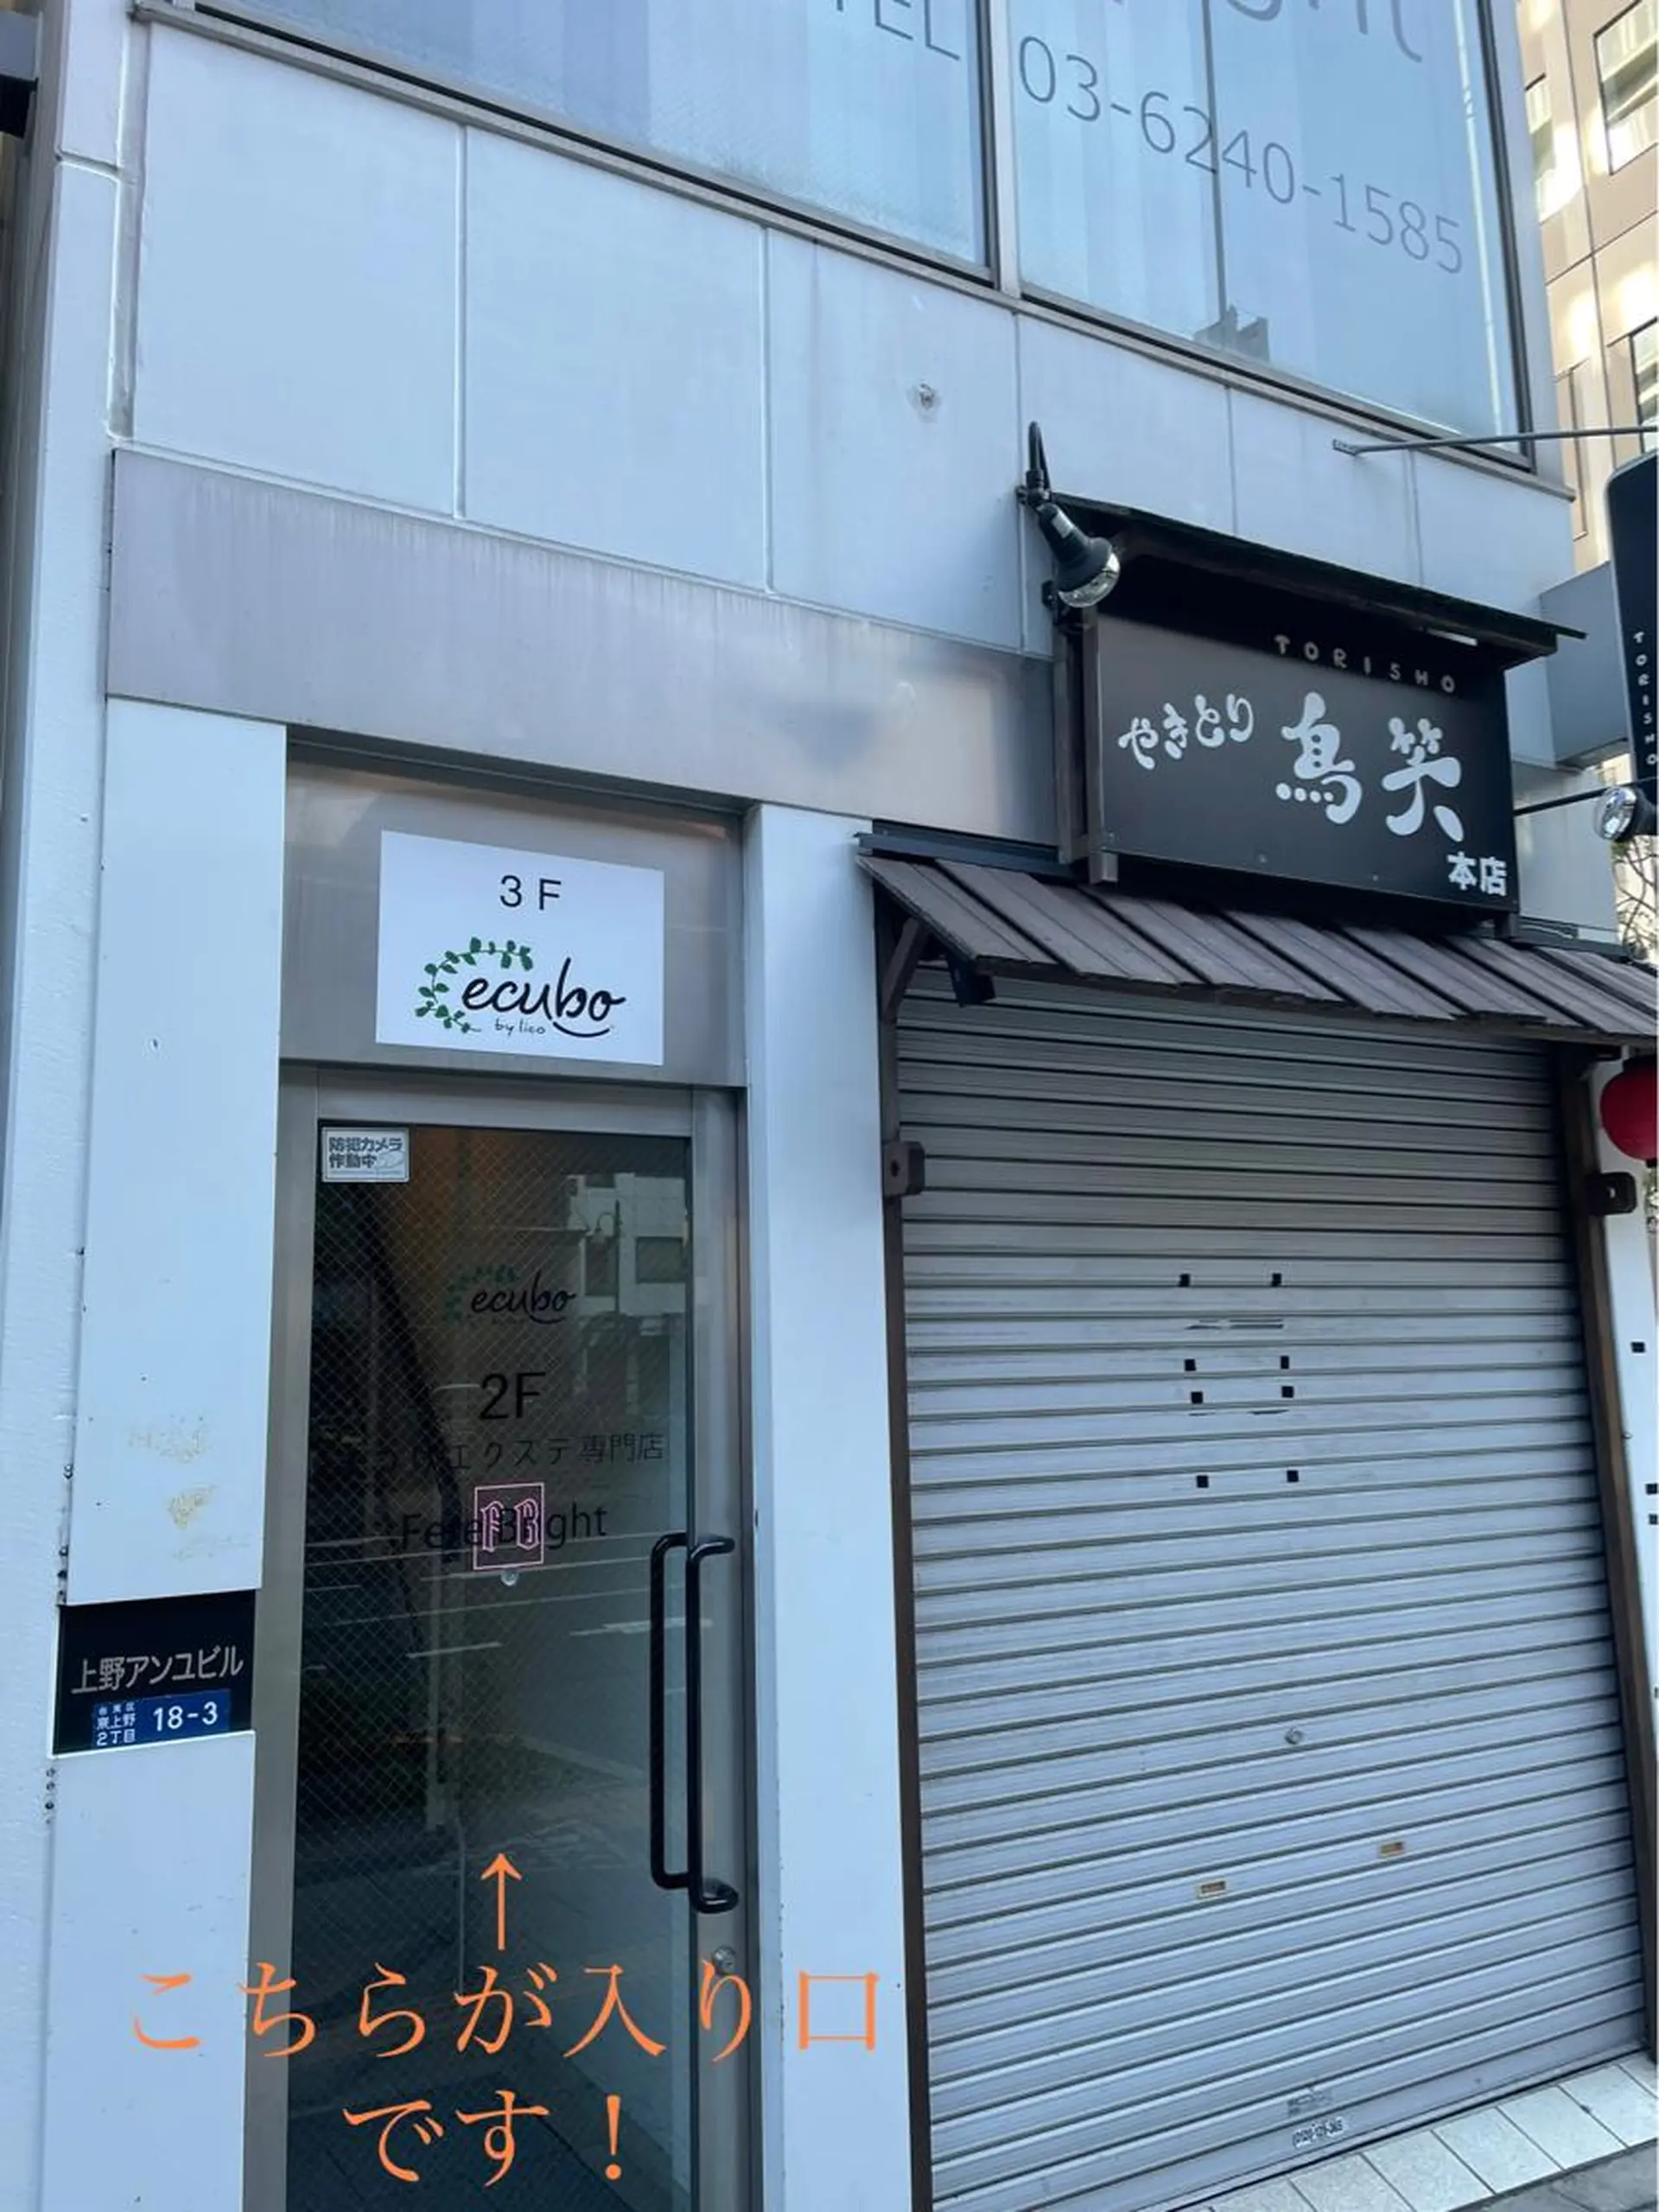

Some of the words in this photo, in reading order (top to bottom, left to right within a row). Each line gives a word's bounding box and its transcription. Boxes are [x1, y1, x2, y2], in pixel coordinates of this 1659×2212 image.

[1018, 35, 1463, 275] 03-6240-1585
[1273, 633, 1457, 695] TORISHO
[1118, 692, 1255, 771] やきとり
[499, 874, 563, 911] 3F
[1446, 850, 1508, 897] 本店
[461, 956, 627, 1038] ecubo
[471, 1268, 577, 1325] ecubo
[480, 1371, 547, 1421] 2F
[153, 1700, 219, 1732] 18-3
